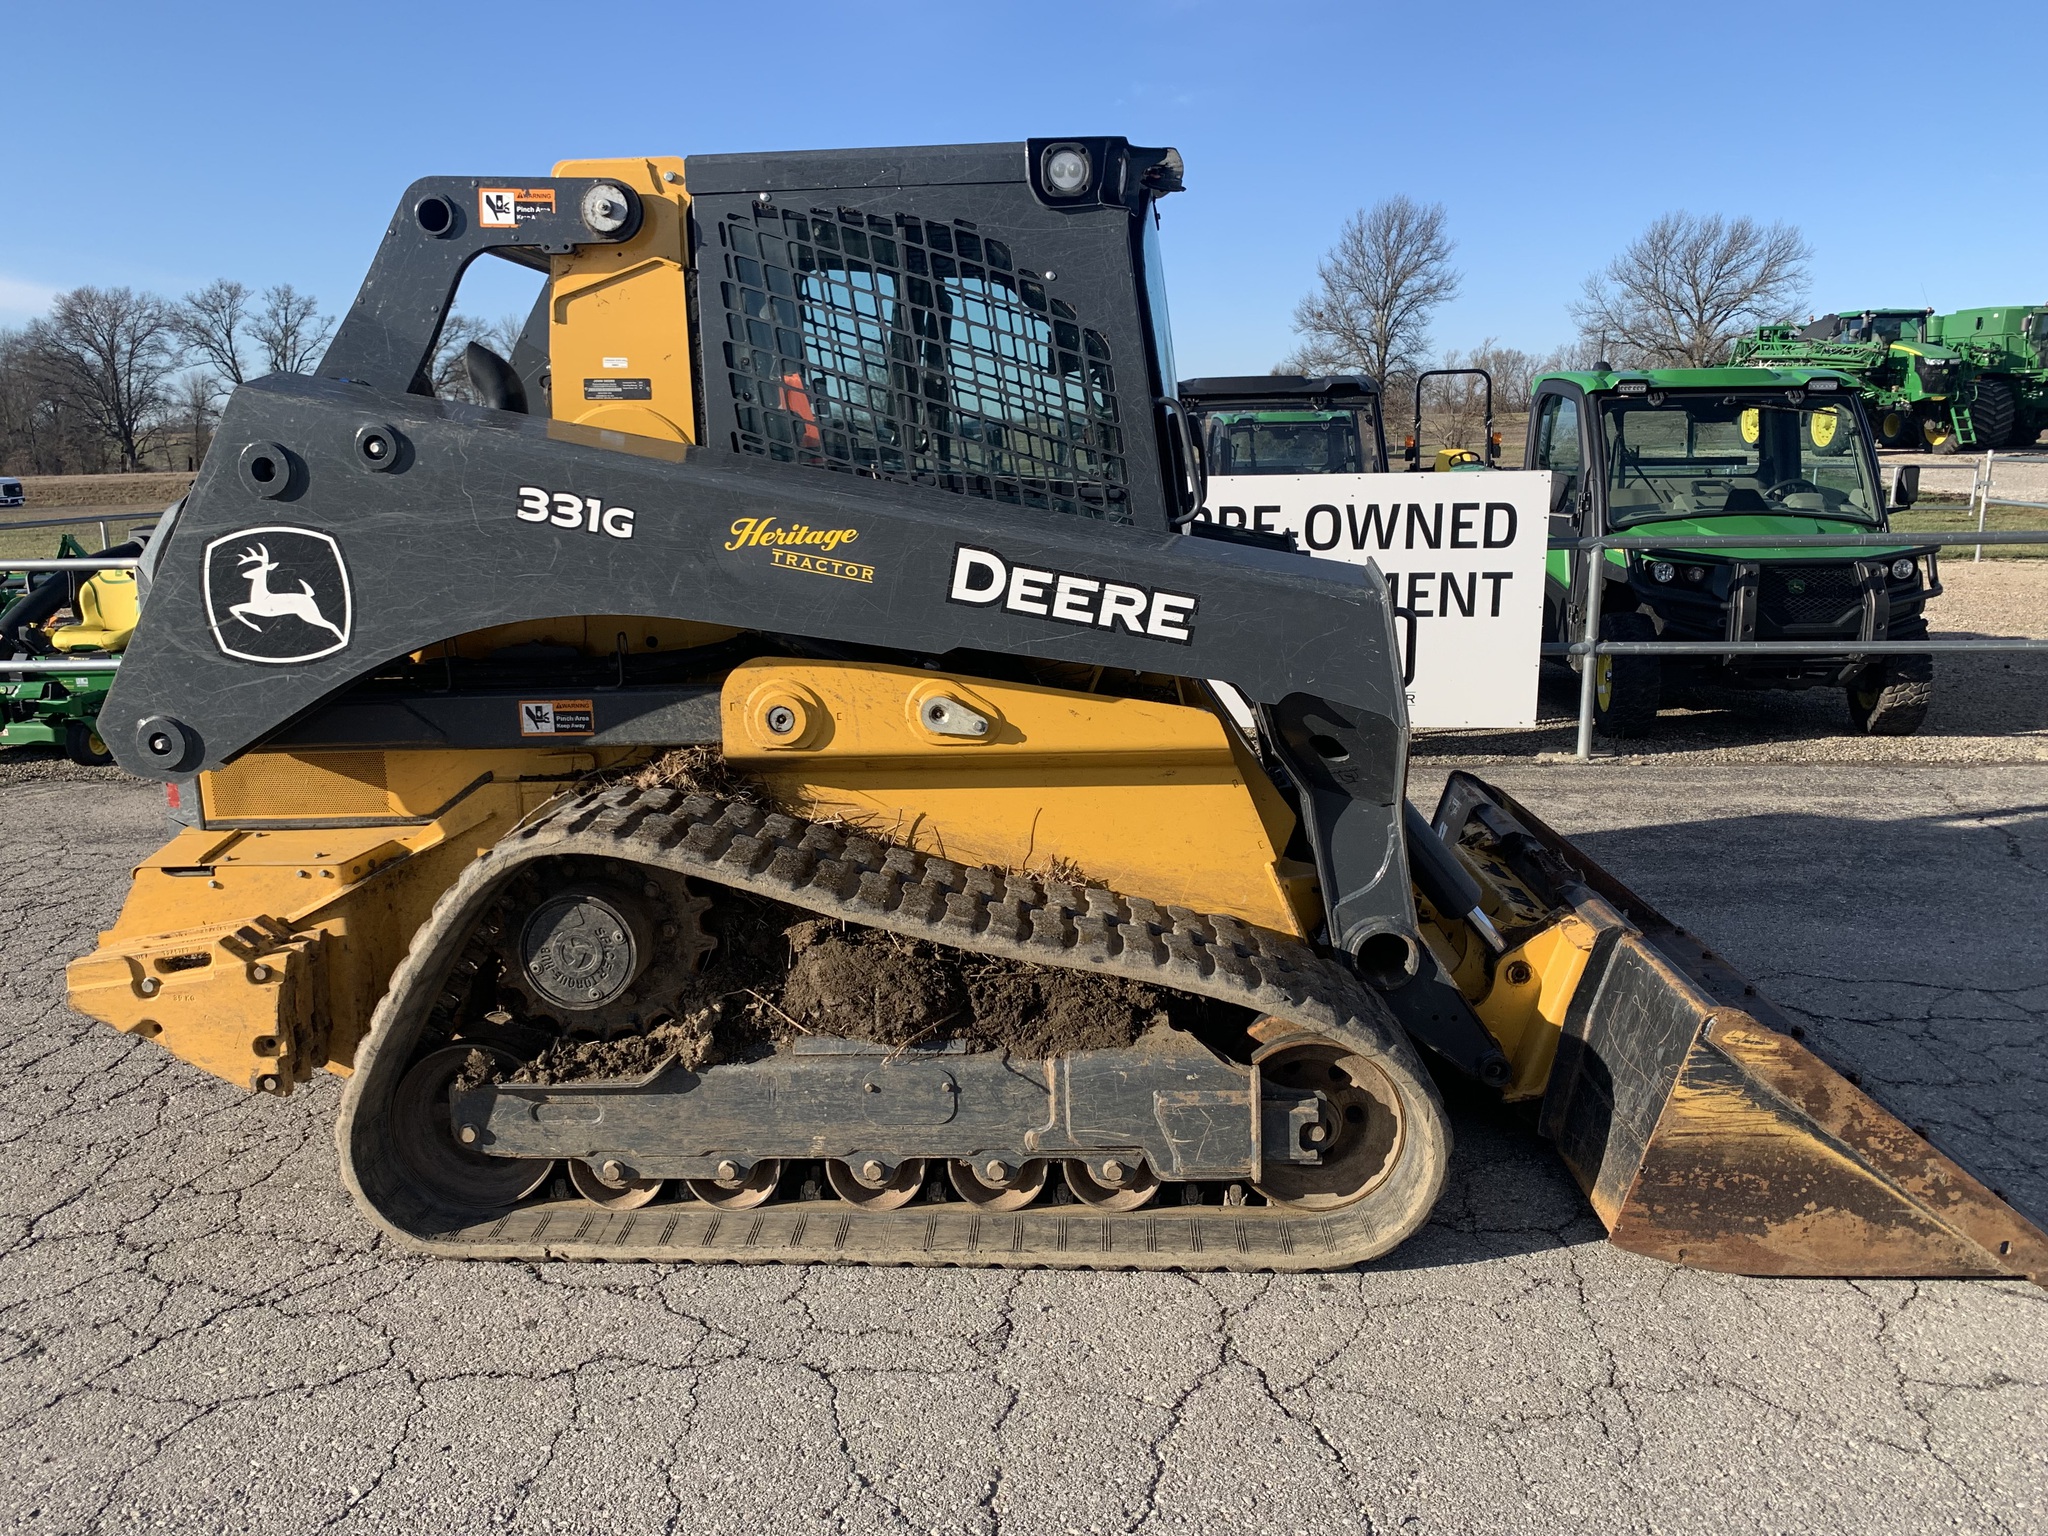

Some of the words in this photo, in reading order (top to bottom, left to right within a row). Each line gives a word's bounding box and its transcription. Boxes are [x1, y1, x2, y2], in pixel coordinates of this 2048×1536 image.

[517, 486, 635, 538] 331G
[724, 516, 860, 552] Heritage
[771, 551, 875, 581] TRACTOR
[951, 547, 1196, 641] DEERE
